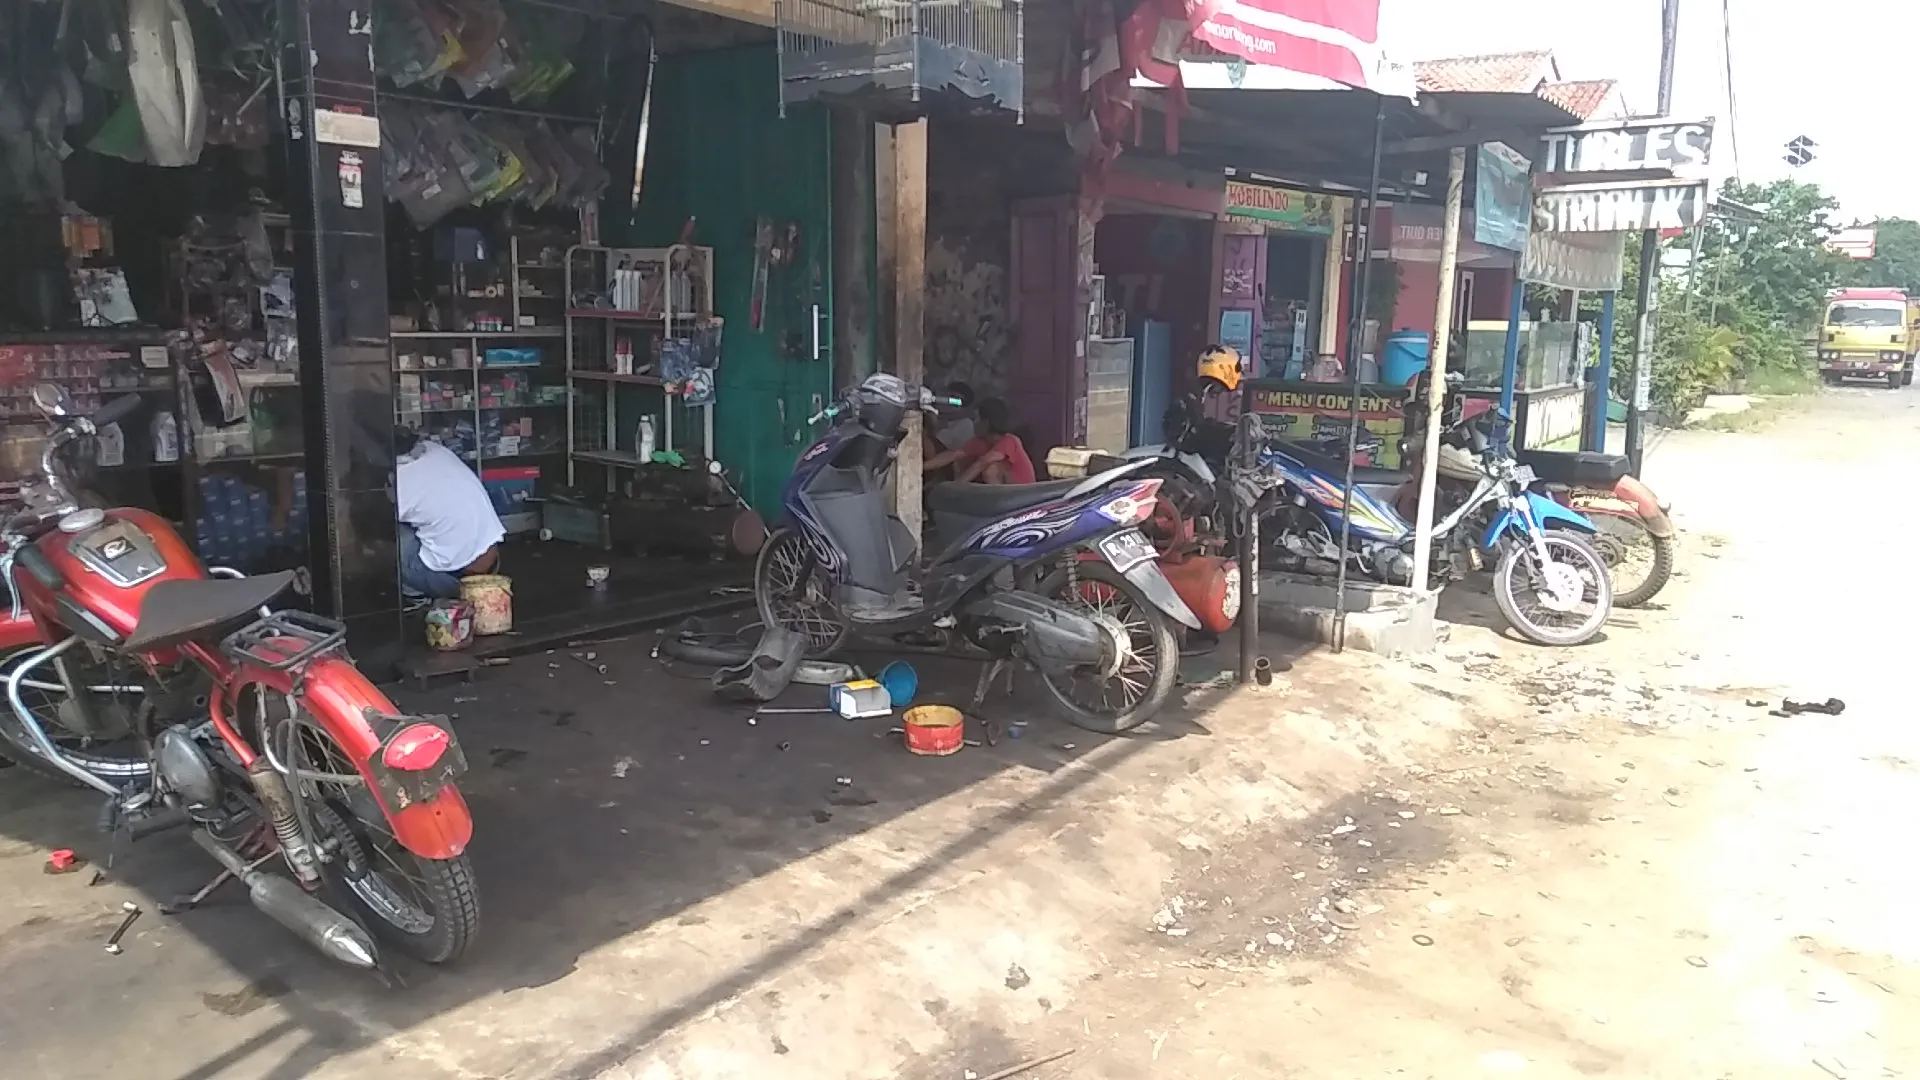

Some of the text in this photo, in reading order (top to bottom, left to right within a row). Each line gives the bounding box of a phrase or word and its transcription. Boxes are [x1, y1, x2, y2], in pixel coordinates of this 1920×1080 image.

[1228, 184, 1290, 212] MOBILINDO
[1267, 391, 1313, 408] MENU
[1105, 542, 1121, 557] R
